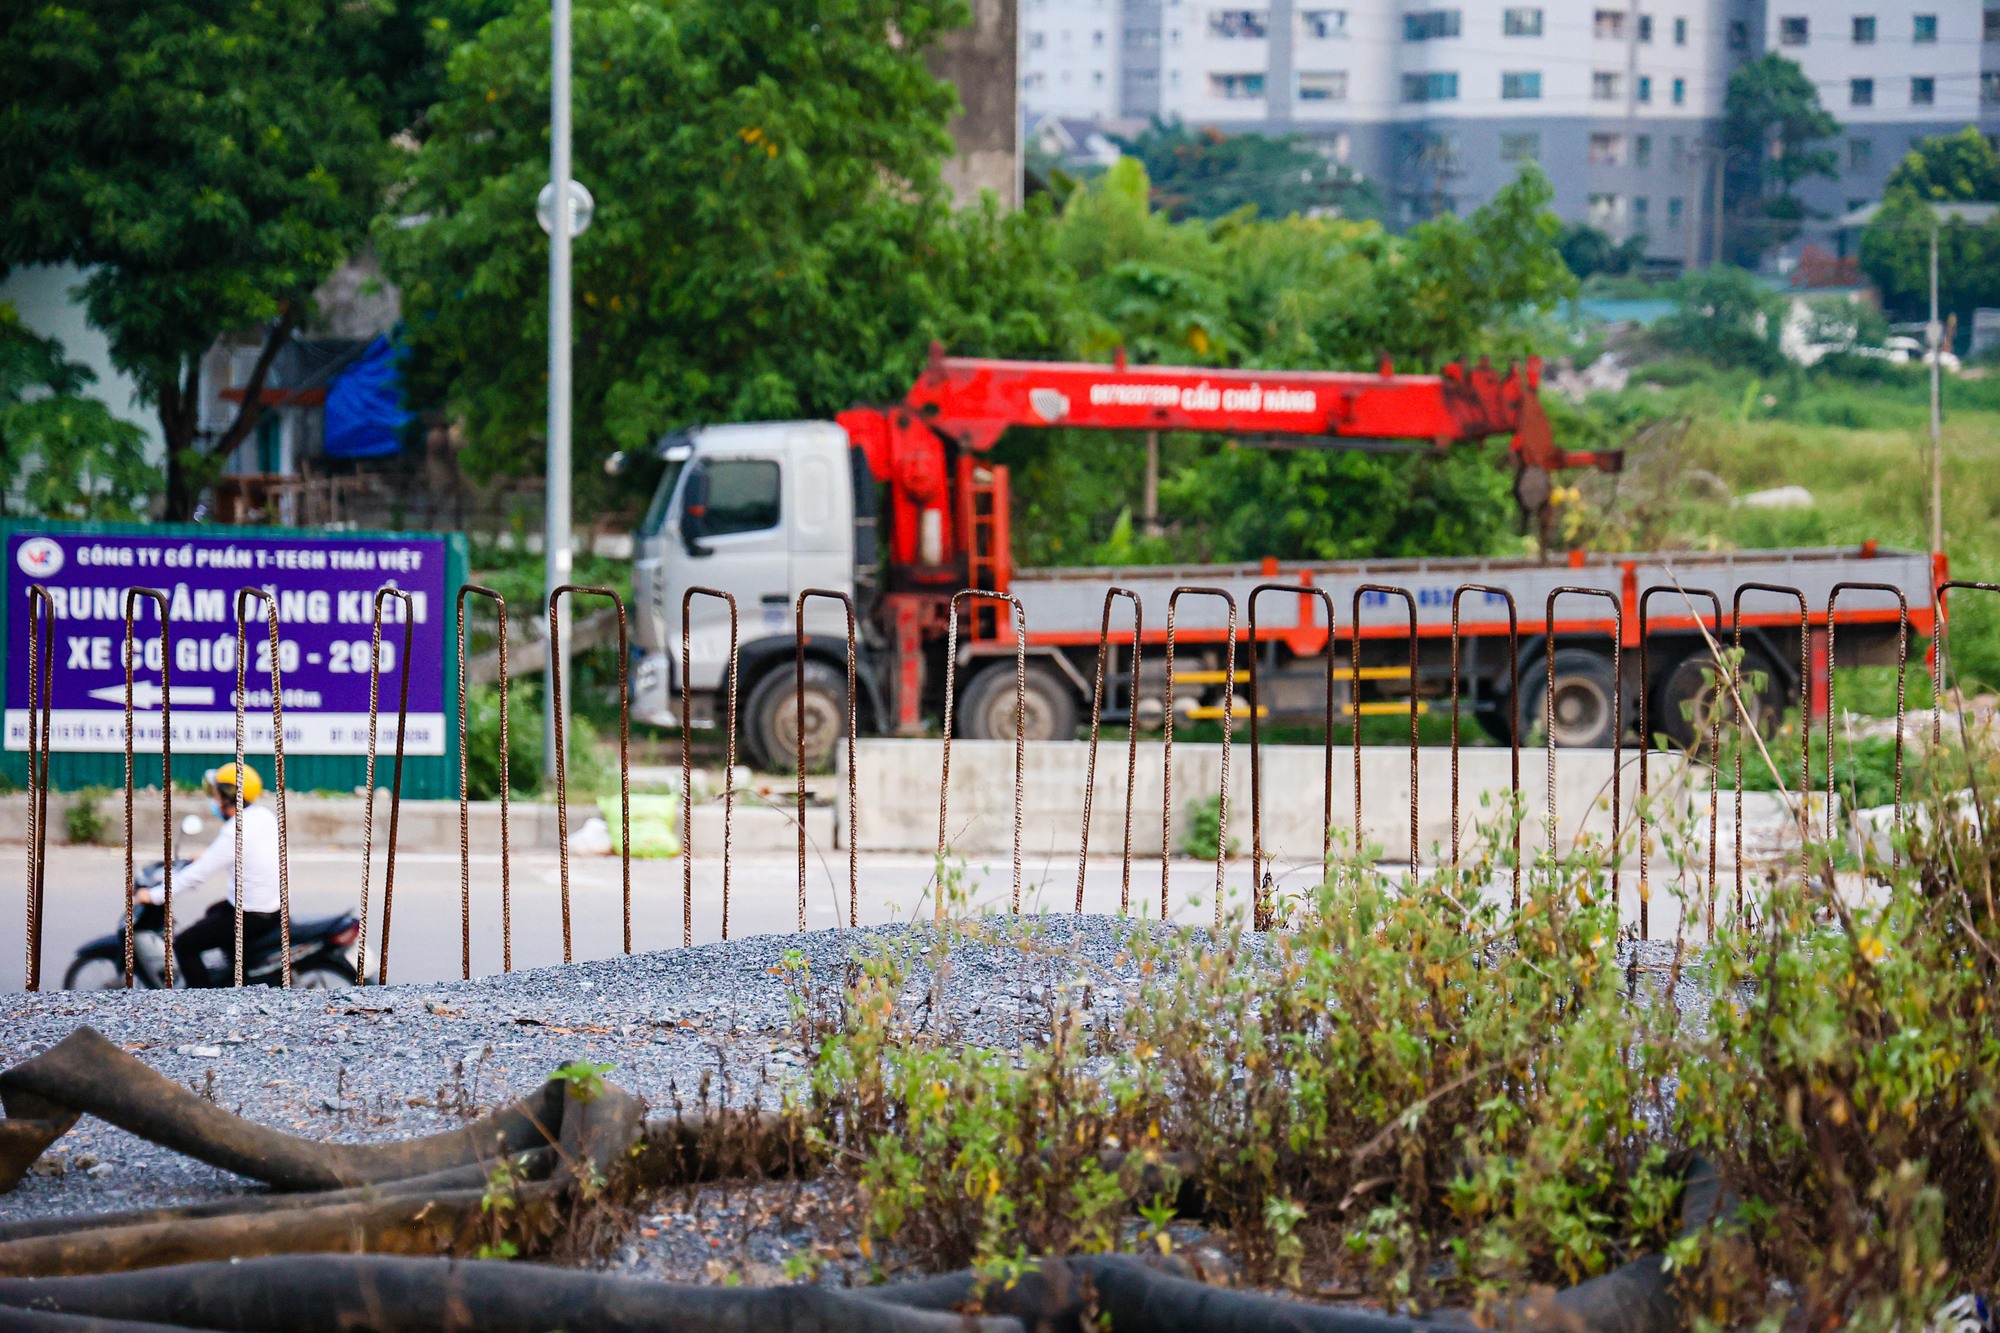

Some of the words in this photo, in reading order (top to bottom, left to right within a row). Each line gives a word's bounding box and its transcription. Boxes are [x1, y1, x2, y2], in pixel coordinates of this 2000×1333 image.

[76, 543, 134, 566] CÔNG
[136, 547, 161, 567] TY
[255, 549, 327, 569] T-TECH
[329, 547, 376, 570] THÁI
[378, 547, 423, 573] VIỆT
[146, 582, 226, 622] TÂM
[232, 583, 330, 624] ĐĂNG
[337, 578, 428, 625] KIỂM
[67, 636, 112, 670] XE
[255, 638, 300, 673] 29
[274, 688, 322, 708] 00m
